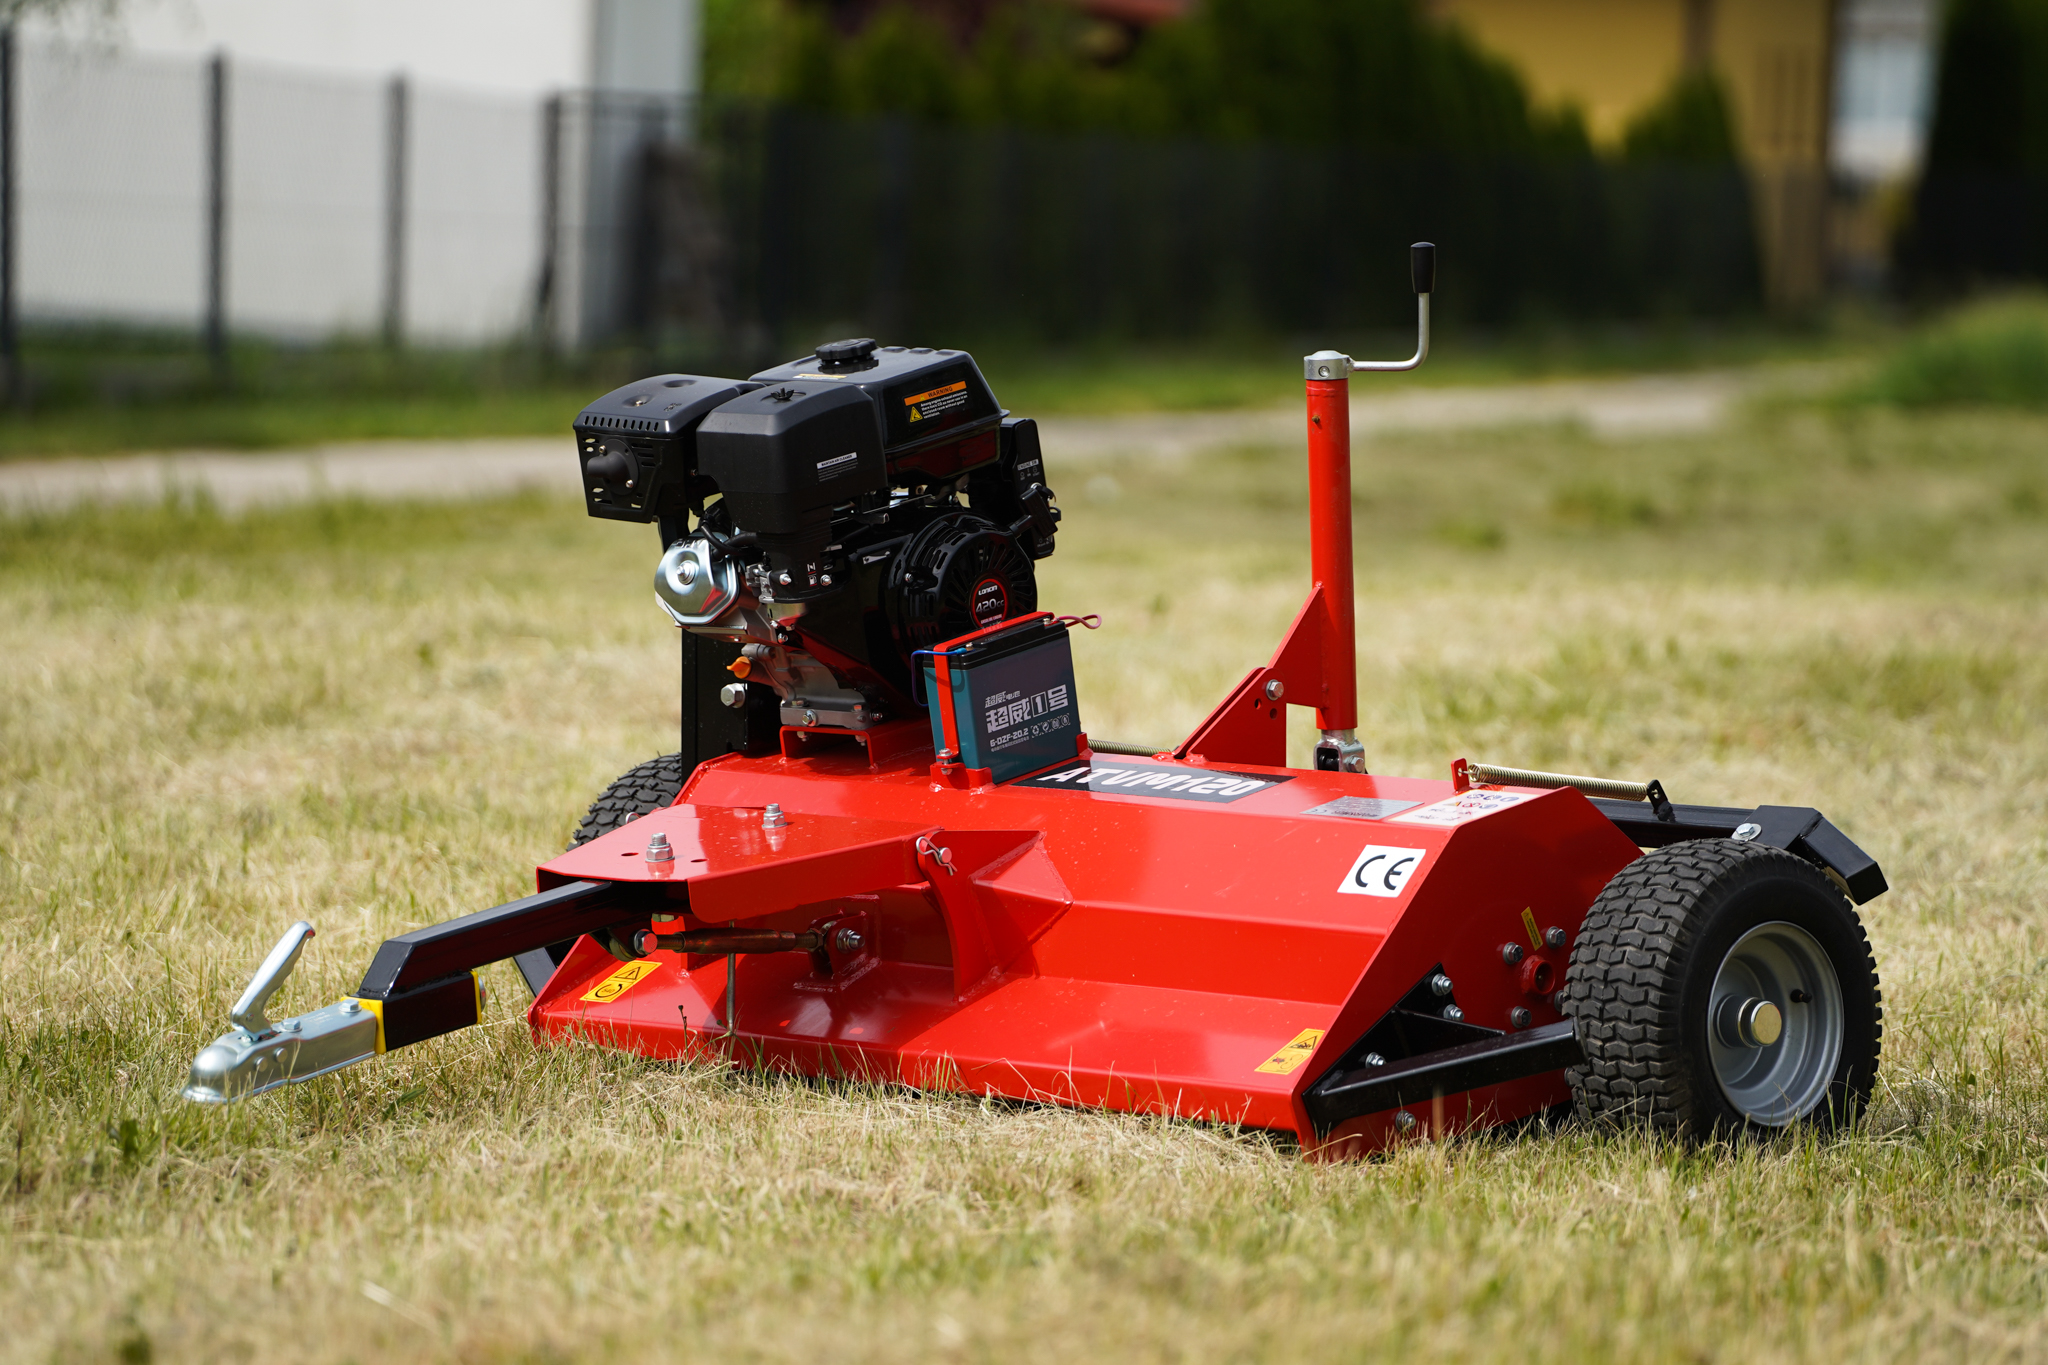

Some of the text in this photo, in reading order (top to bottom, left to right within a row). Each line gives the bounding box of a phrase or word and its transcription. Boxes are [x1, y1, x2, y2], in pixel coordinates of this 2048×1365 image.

[928, 386, 952, 397] WARNING
[976, 598, 1004, 613] 420cc
[1036, 766, 1266, 796] ATVM120
[1355, 854, 1415, 890] CE
